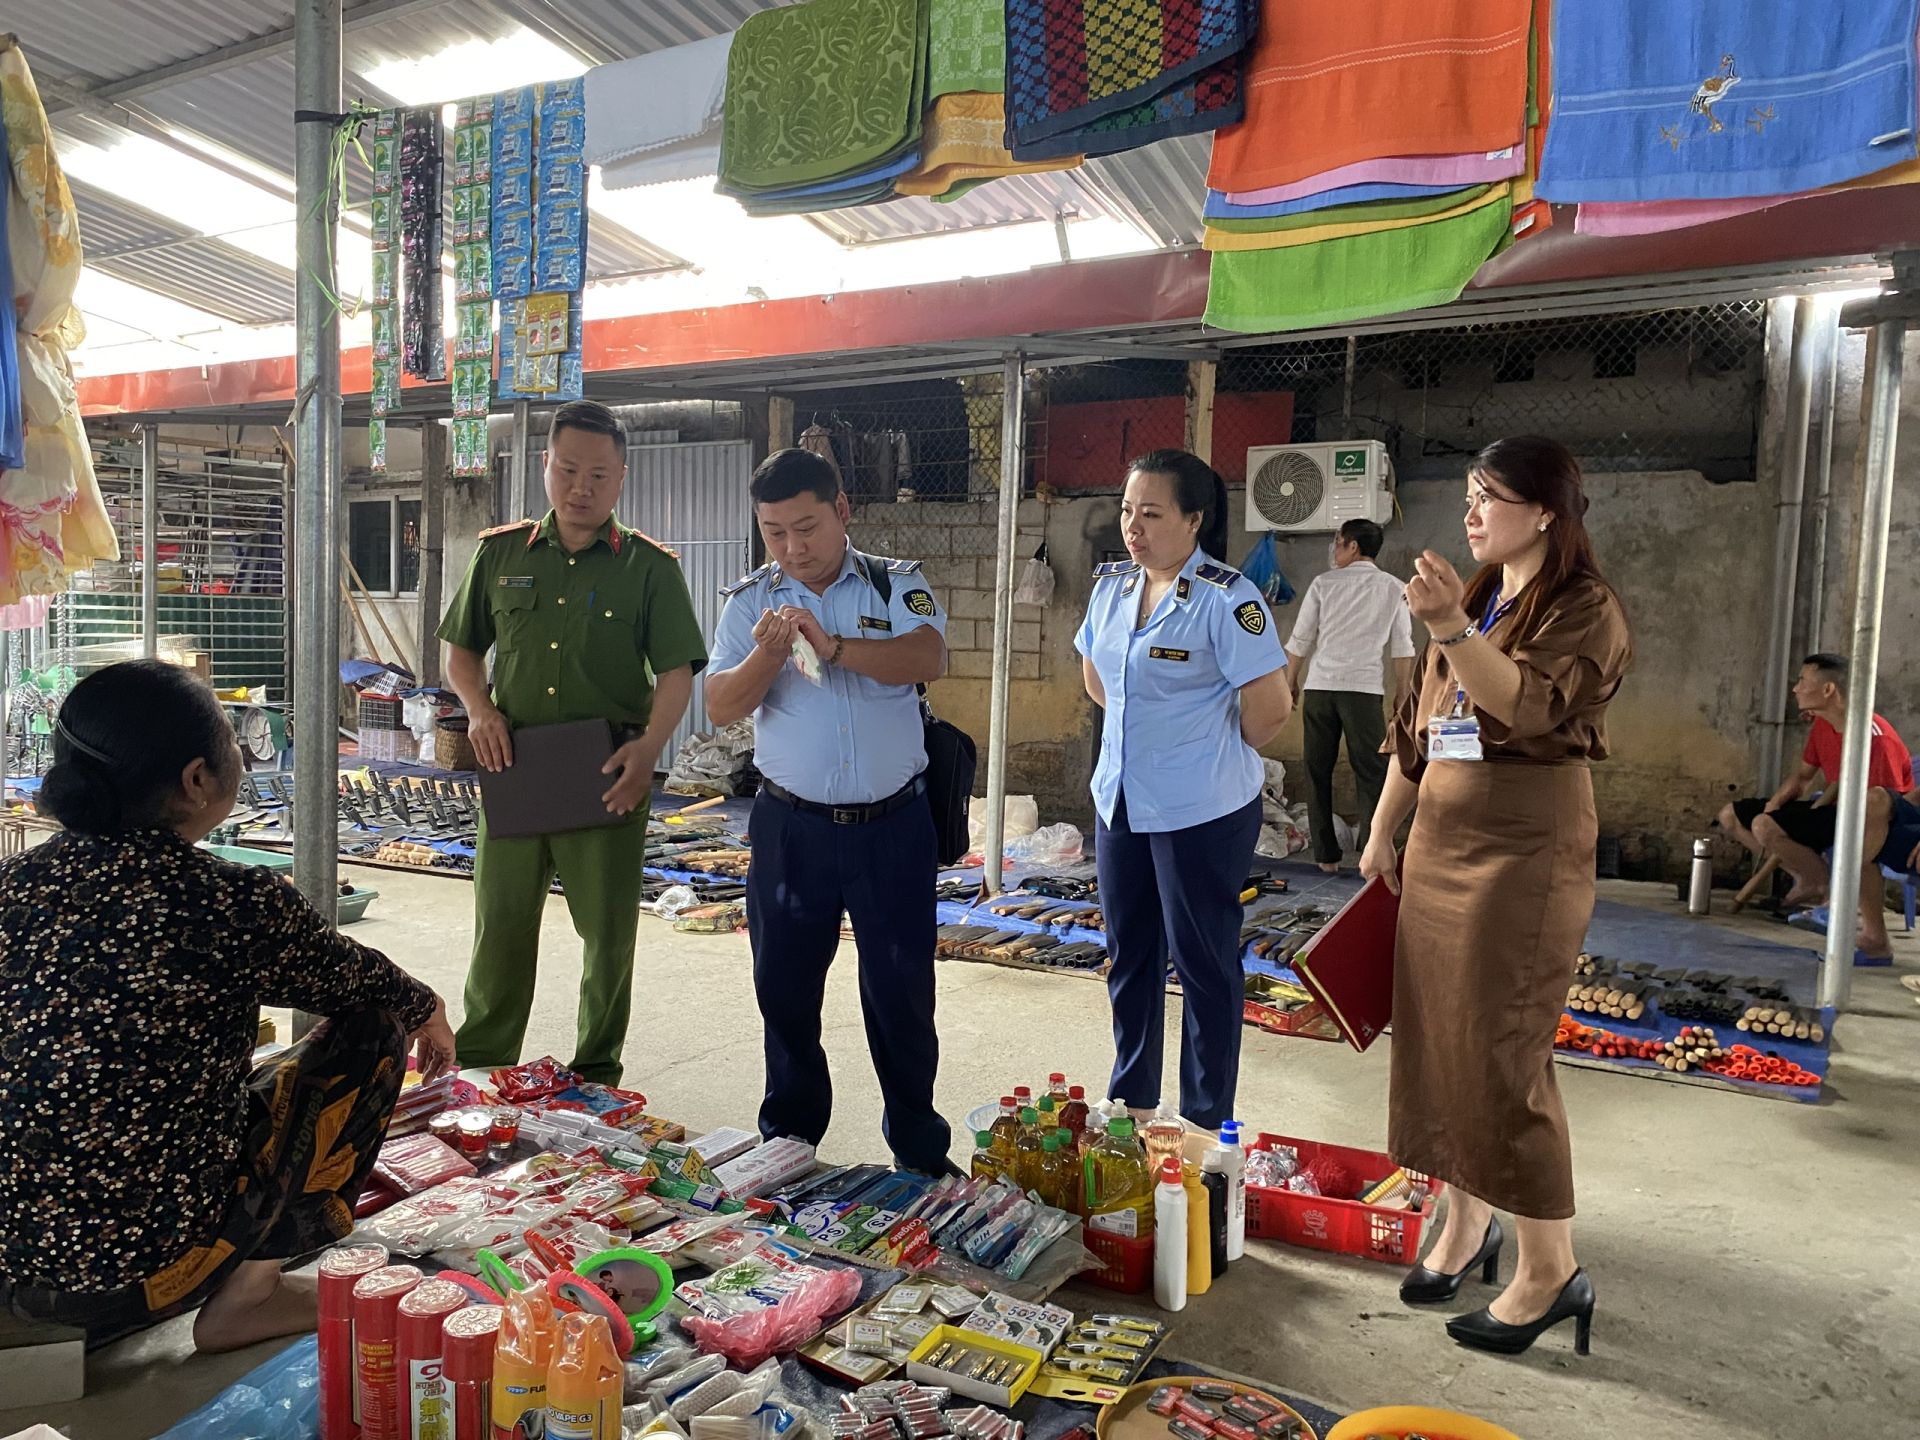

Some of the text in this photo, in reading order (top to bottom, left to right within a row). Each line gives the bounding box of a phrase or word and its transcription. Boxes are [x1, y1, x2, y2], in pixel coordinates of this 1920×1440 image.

[1240, 603, 1256, 614] DMS
[291, 1089, 325, 1164] stories
[891, 1218, 922, 1243] Colgate
[967, 1313, 996, 1330] 502
[1008, 1306, 1037, 1321] 502
[1038, 1310, 1067, 1328] 502
[555, 1412, 577, 1423] VAPE
[579, 1413, 592, 1423] G3
